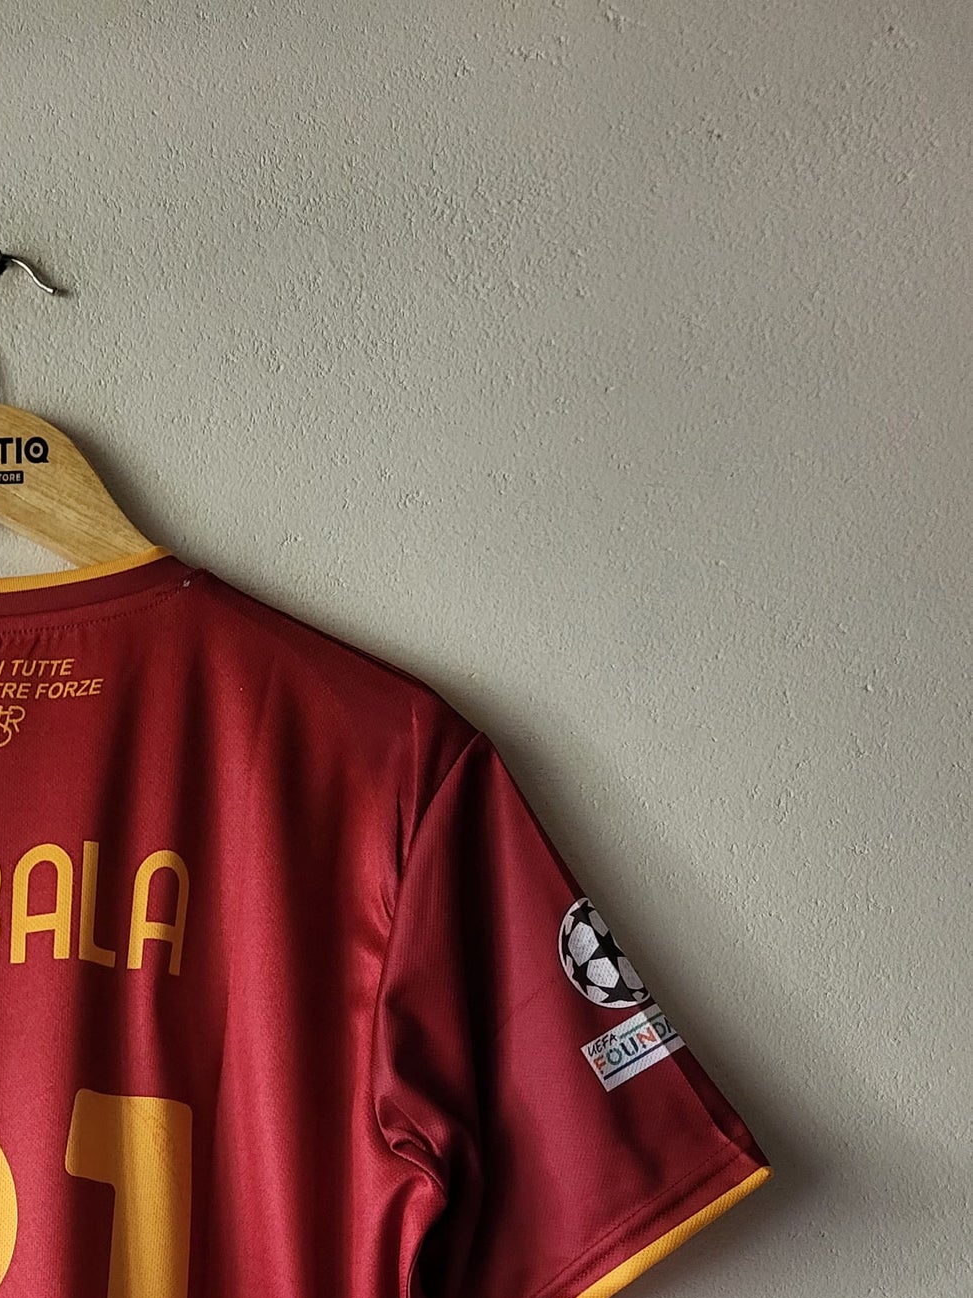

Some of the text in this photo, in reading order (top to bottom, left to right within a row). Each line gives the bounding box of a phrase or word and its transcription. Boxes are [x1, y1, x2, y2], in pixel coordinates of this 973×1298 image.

[11, 658, 75, 677] TUTTE
[34, 678, 104, 700] FORZE
[587, 1032, 618, 1058] UEFA
